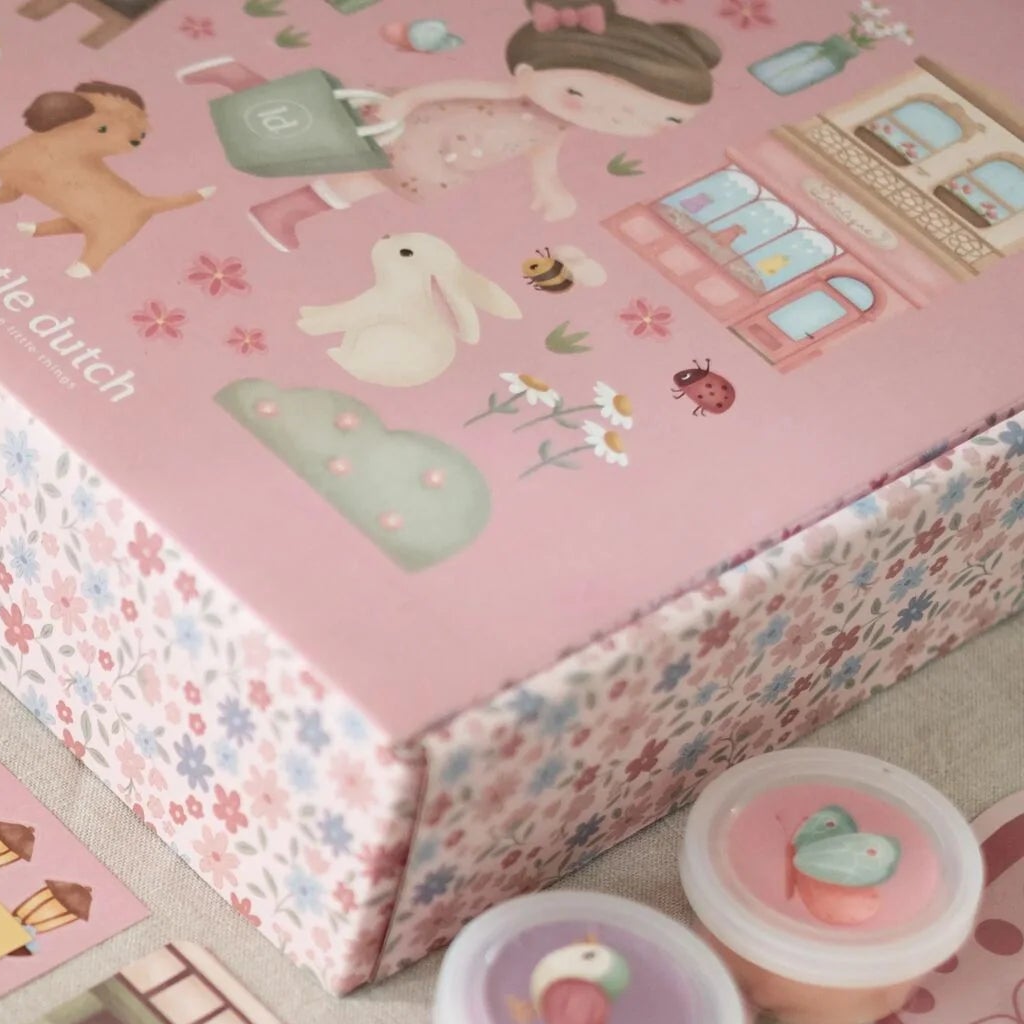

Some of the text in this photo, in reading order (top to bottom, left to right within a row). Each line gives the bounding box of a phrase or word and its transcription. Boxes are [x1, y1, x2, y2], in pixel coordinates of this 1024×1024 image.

[6, 325, 37, 354] little
[37, 354, 77, 390] things
[28, 314, 136, 403] dutch
